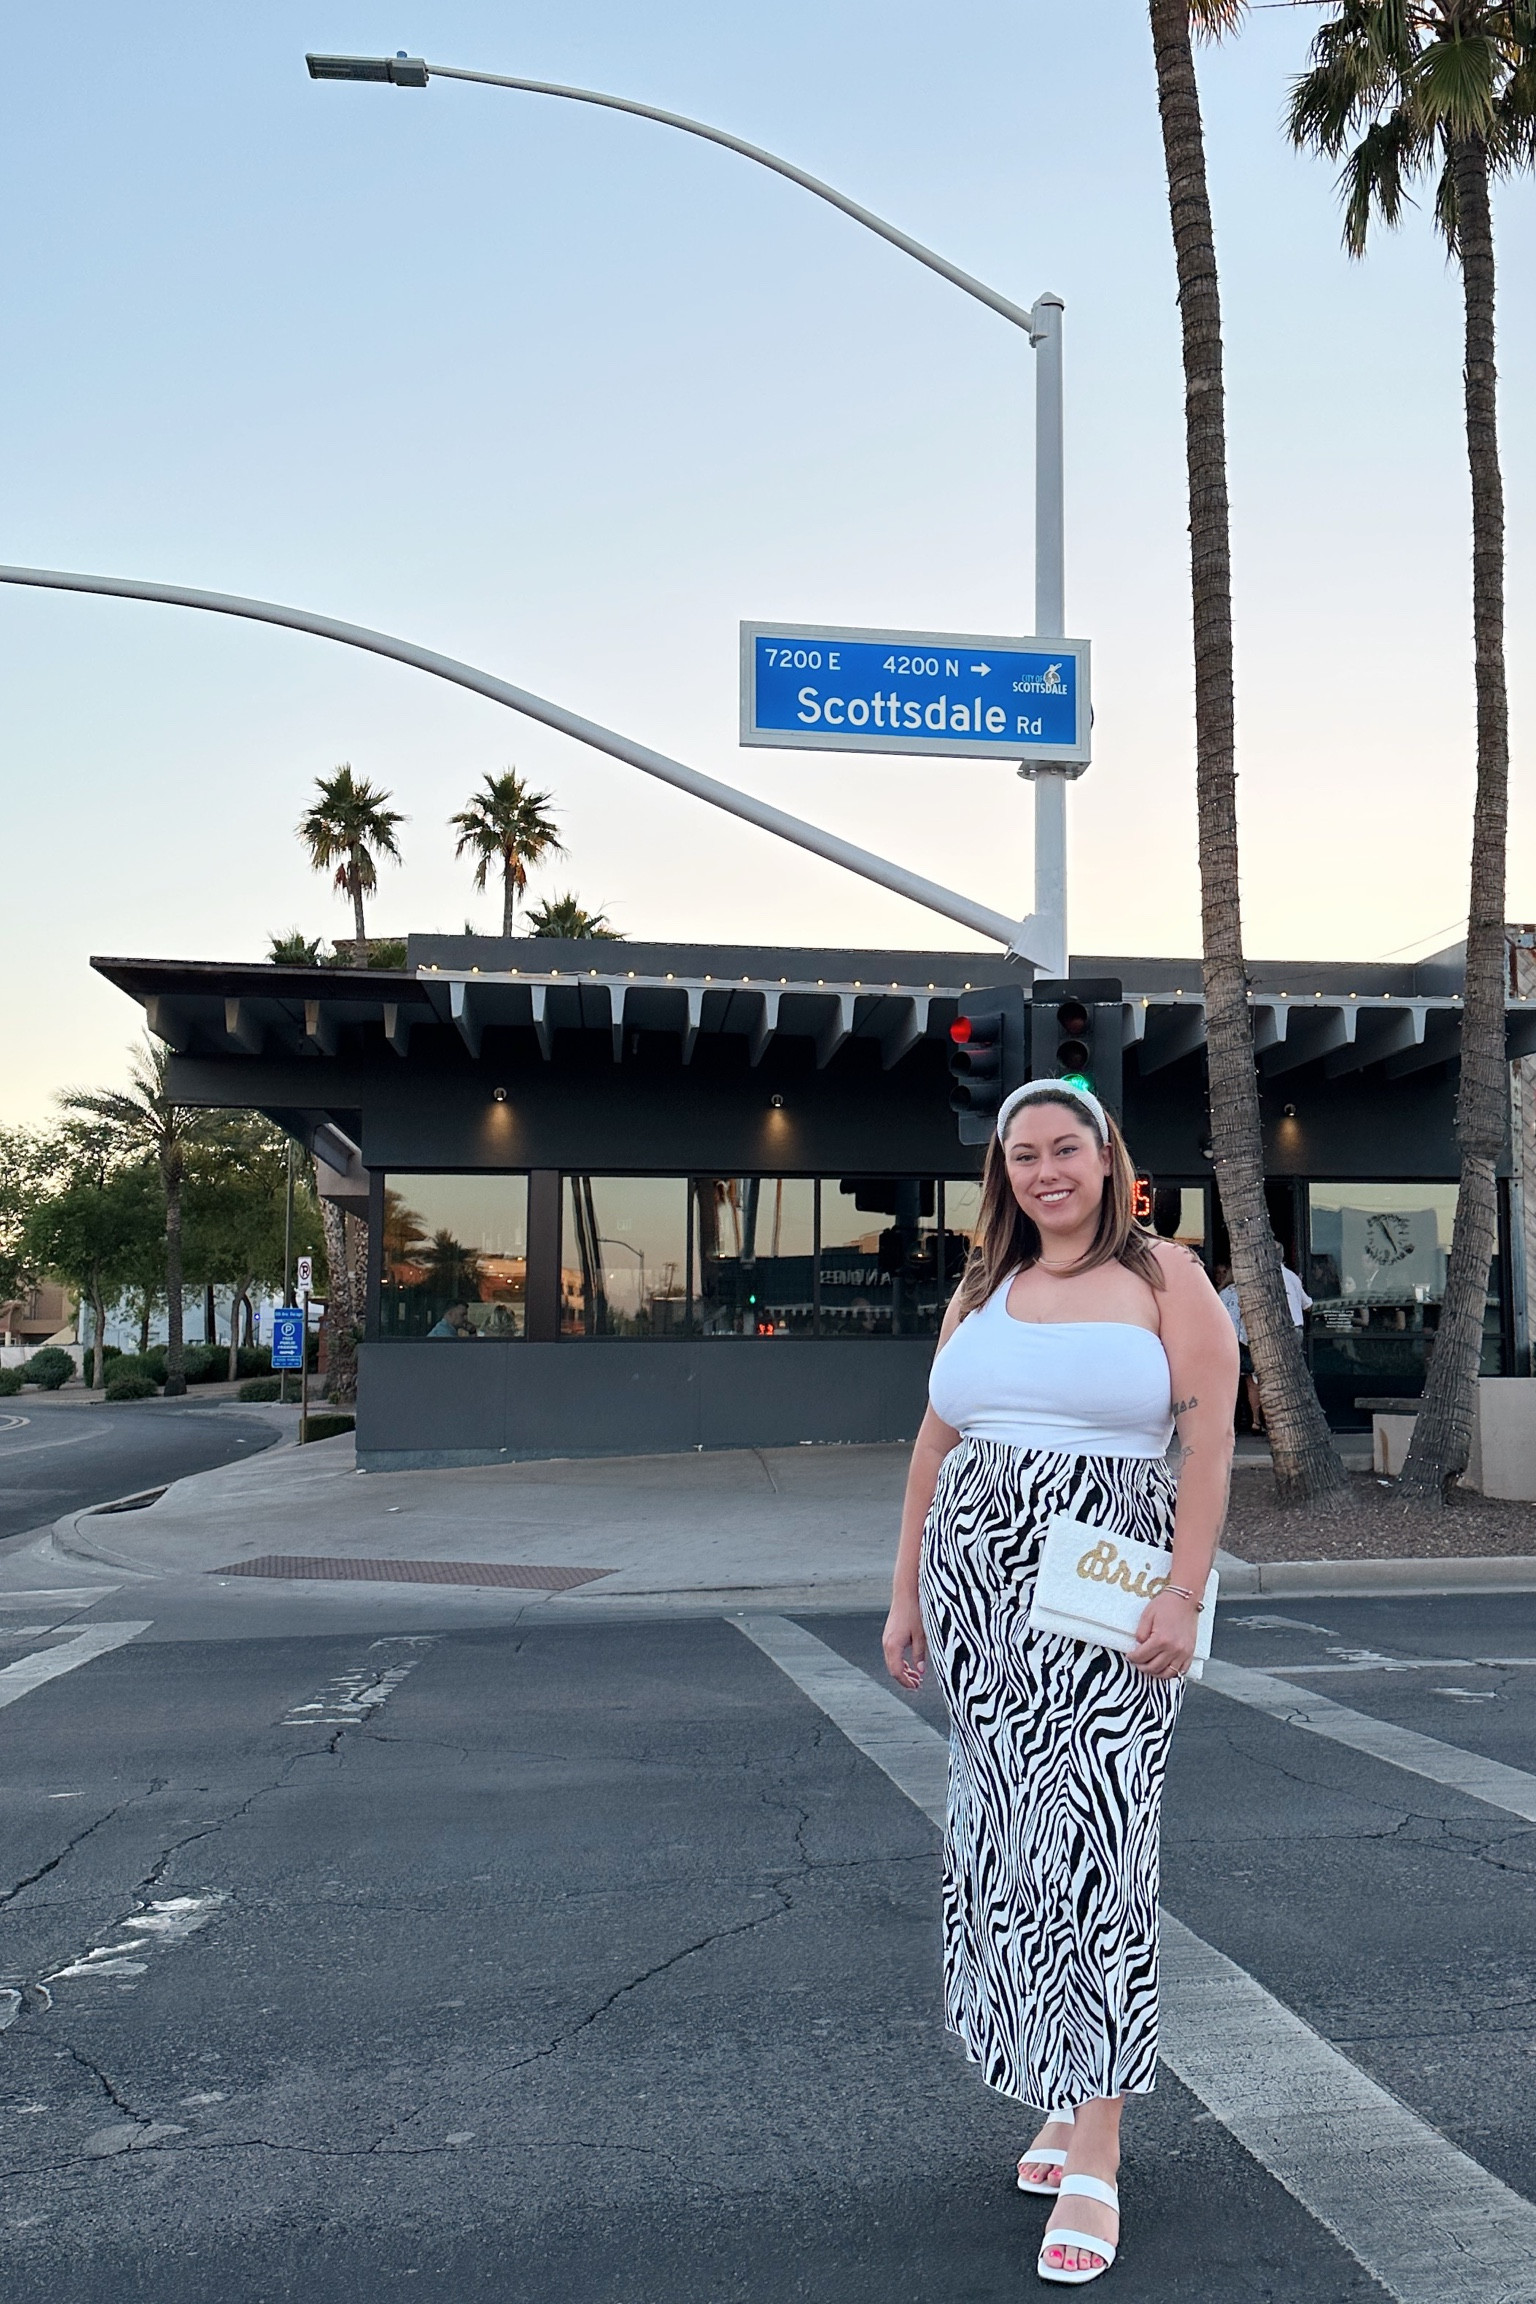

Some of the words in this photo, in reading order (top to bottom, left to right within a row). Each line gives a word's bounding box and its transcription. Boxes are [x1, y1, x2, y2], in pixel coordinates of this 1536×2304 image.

[765, 648, 822, 670] 7200
[829, 652, 841, 670] E
[882, 655, 939, 676] 4200
[945, 659, 959, 677] N
[1012, 681, 1068, 695] SCOTTSDALE
[1021, 674, 1034, 682] CITY
[797, 686, 1007, 733] Scottsdale
[1016, 716, 1042, 735] Rd
